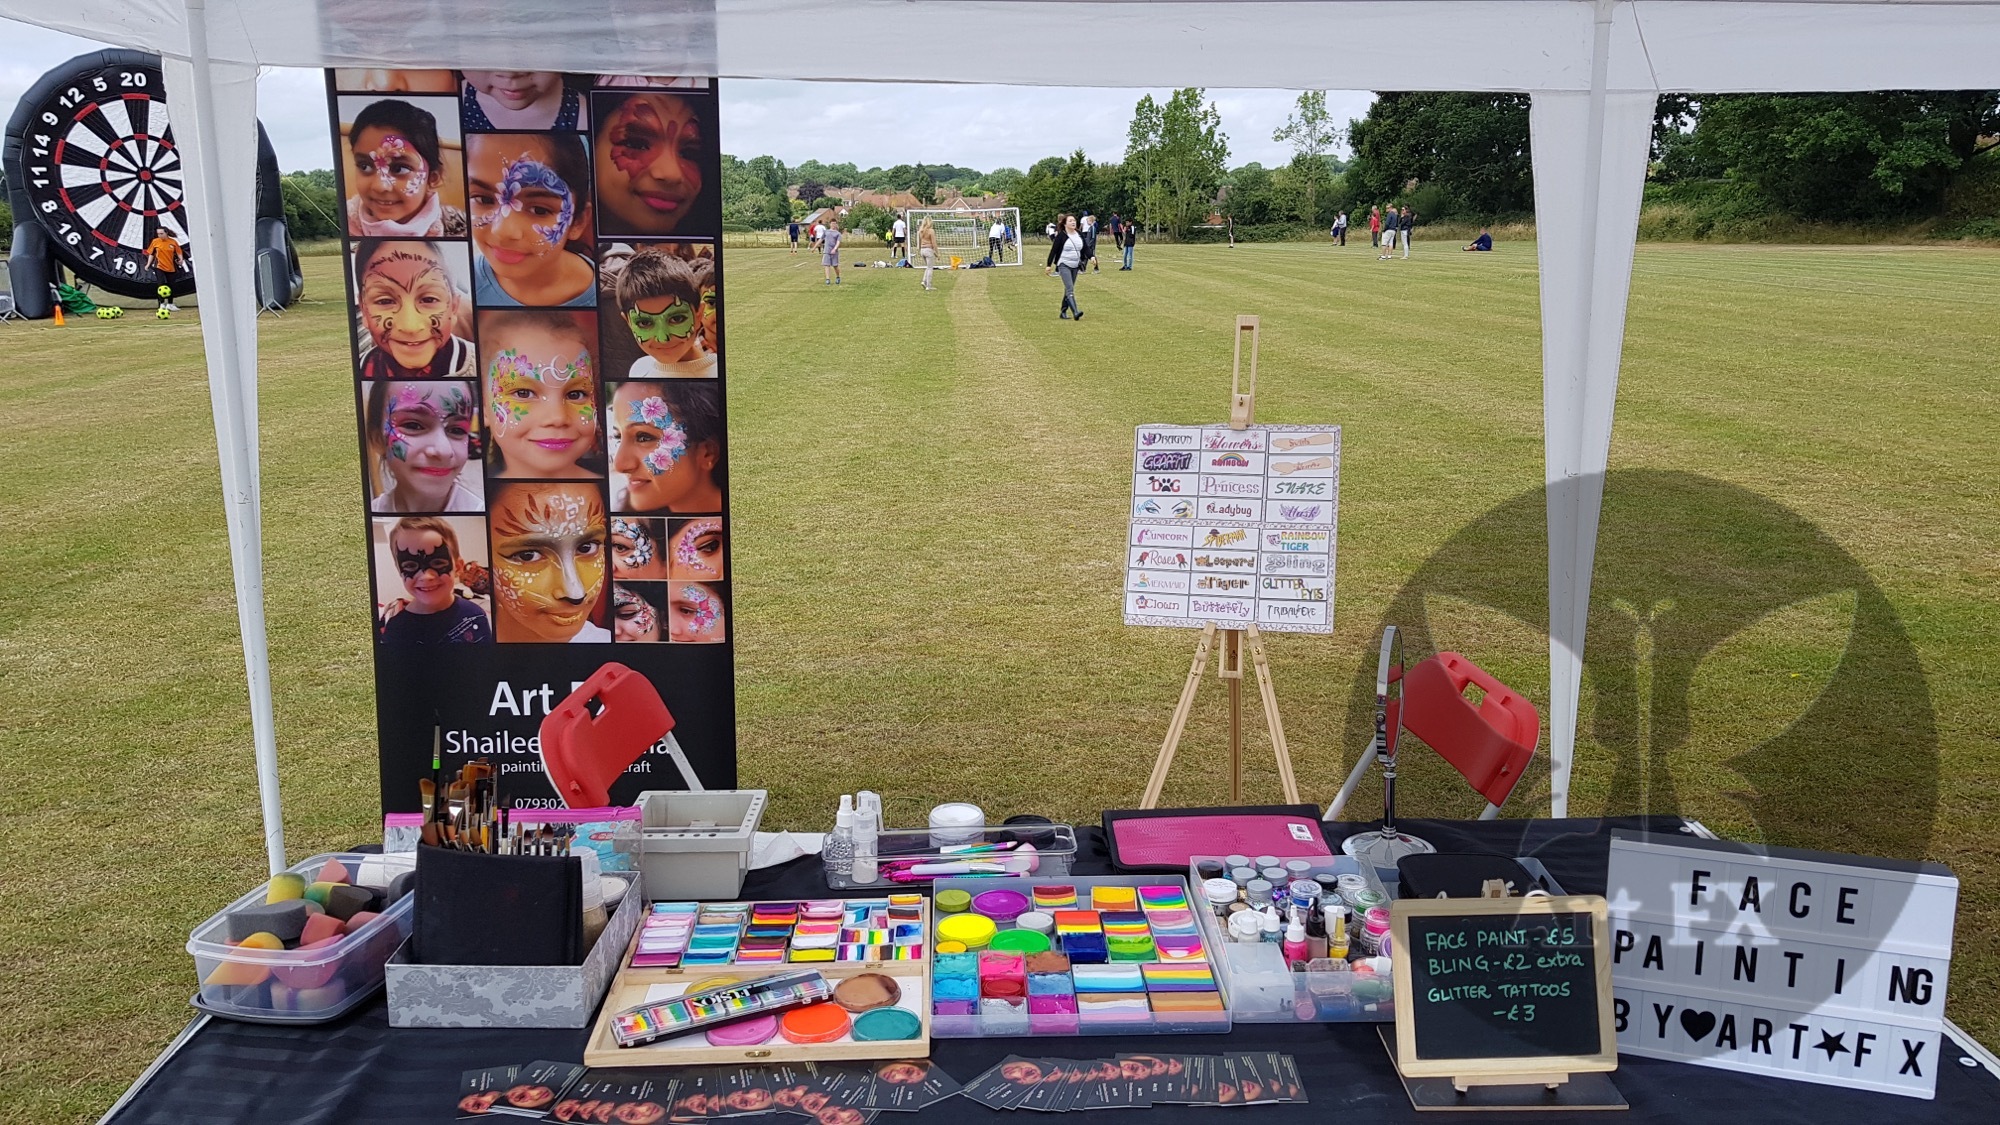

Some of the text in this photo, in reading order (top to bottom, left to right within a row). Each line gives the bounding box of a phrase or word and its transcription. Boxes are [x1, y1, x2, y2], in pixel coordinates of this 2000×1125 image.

[92, 77, 108, 92] 5
[120, 73, 147, 87] 20
[59, 87, 85, 109] 12
[42, 112, 58, 126] 9
[33, 134, 51, 157] 14
[31, 166, 49, 188] 11
[42, 200, 58, 213] 8
[58, 223, 82, 245] 16
[89, 247, 104, 261] 7
[113, 257, 137, 274] 19
[1281, 531, 1327, 541] RAINBOW
[1281, 542, 1309, 551] TIGER
[1262, 577, 1305, 589] GLITTER
[1301, 588, 1324, 600] EYES
[489, 680, 554, 716] Art
[1691, 869, 1860, 925] FACE
[1425, 931, 1468, 951] FACE
[1477, 930, 1527, 947] PAINT
[1546, 927, 1575, 945] £5
[1536, 951, 1585, 969] extra
[1613, 929, 1934, 1006] PAINTING
[1427, 982, 1571, 1003] GLITTER TATTOOS
